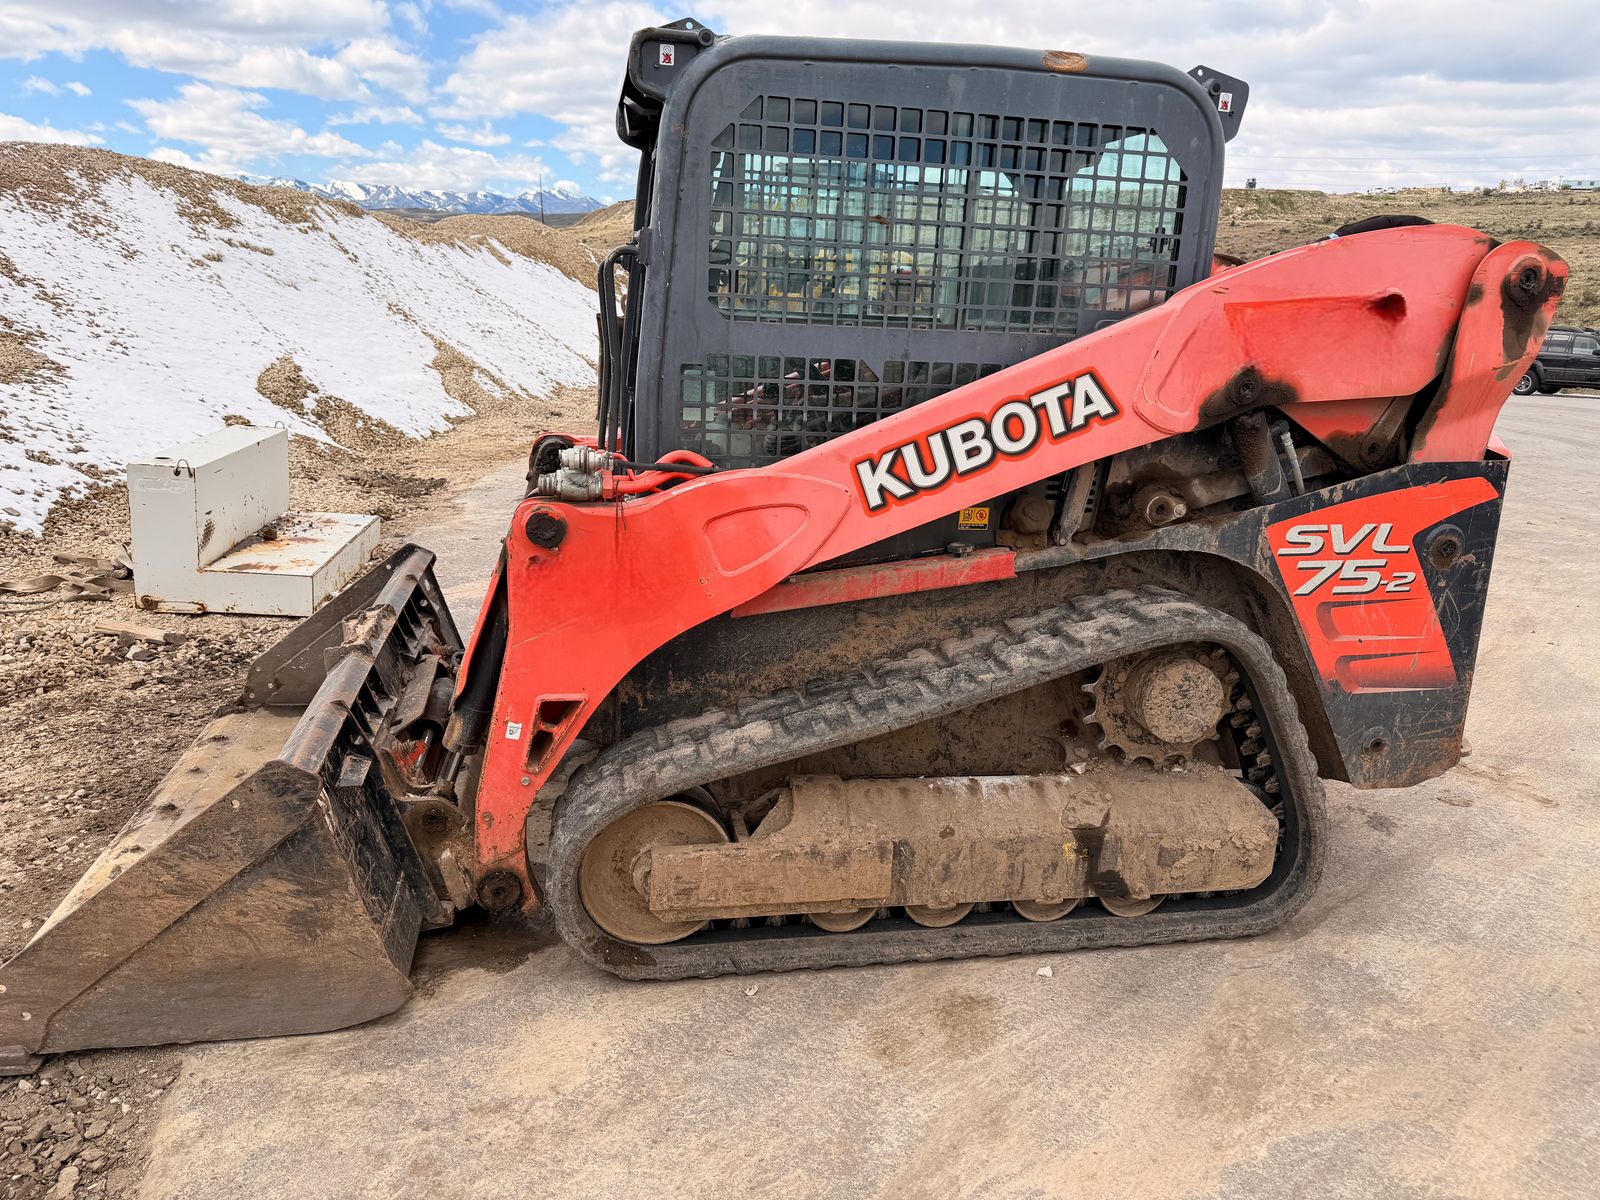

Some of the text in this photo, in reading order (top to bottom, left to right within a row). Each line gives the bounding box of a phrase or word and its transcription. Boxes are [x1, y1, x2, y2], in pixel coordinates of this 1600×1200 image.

[856, 373, 1117, 510] KUBOTA
[1277, 523, 1411, 556] SVL
[1293, 559, 1416, 596] 75-2
